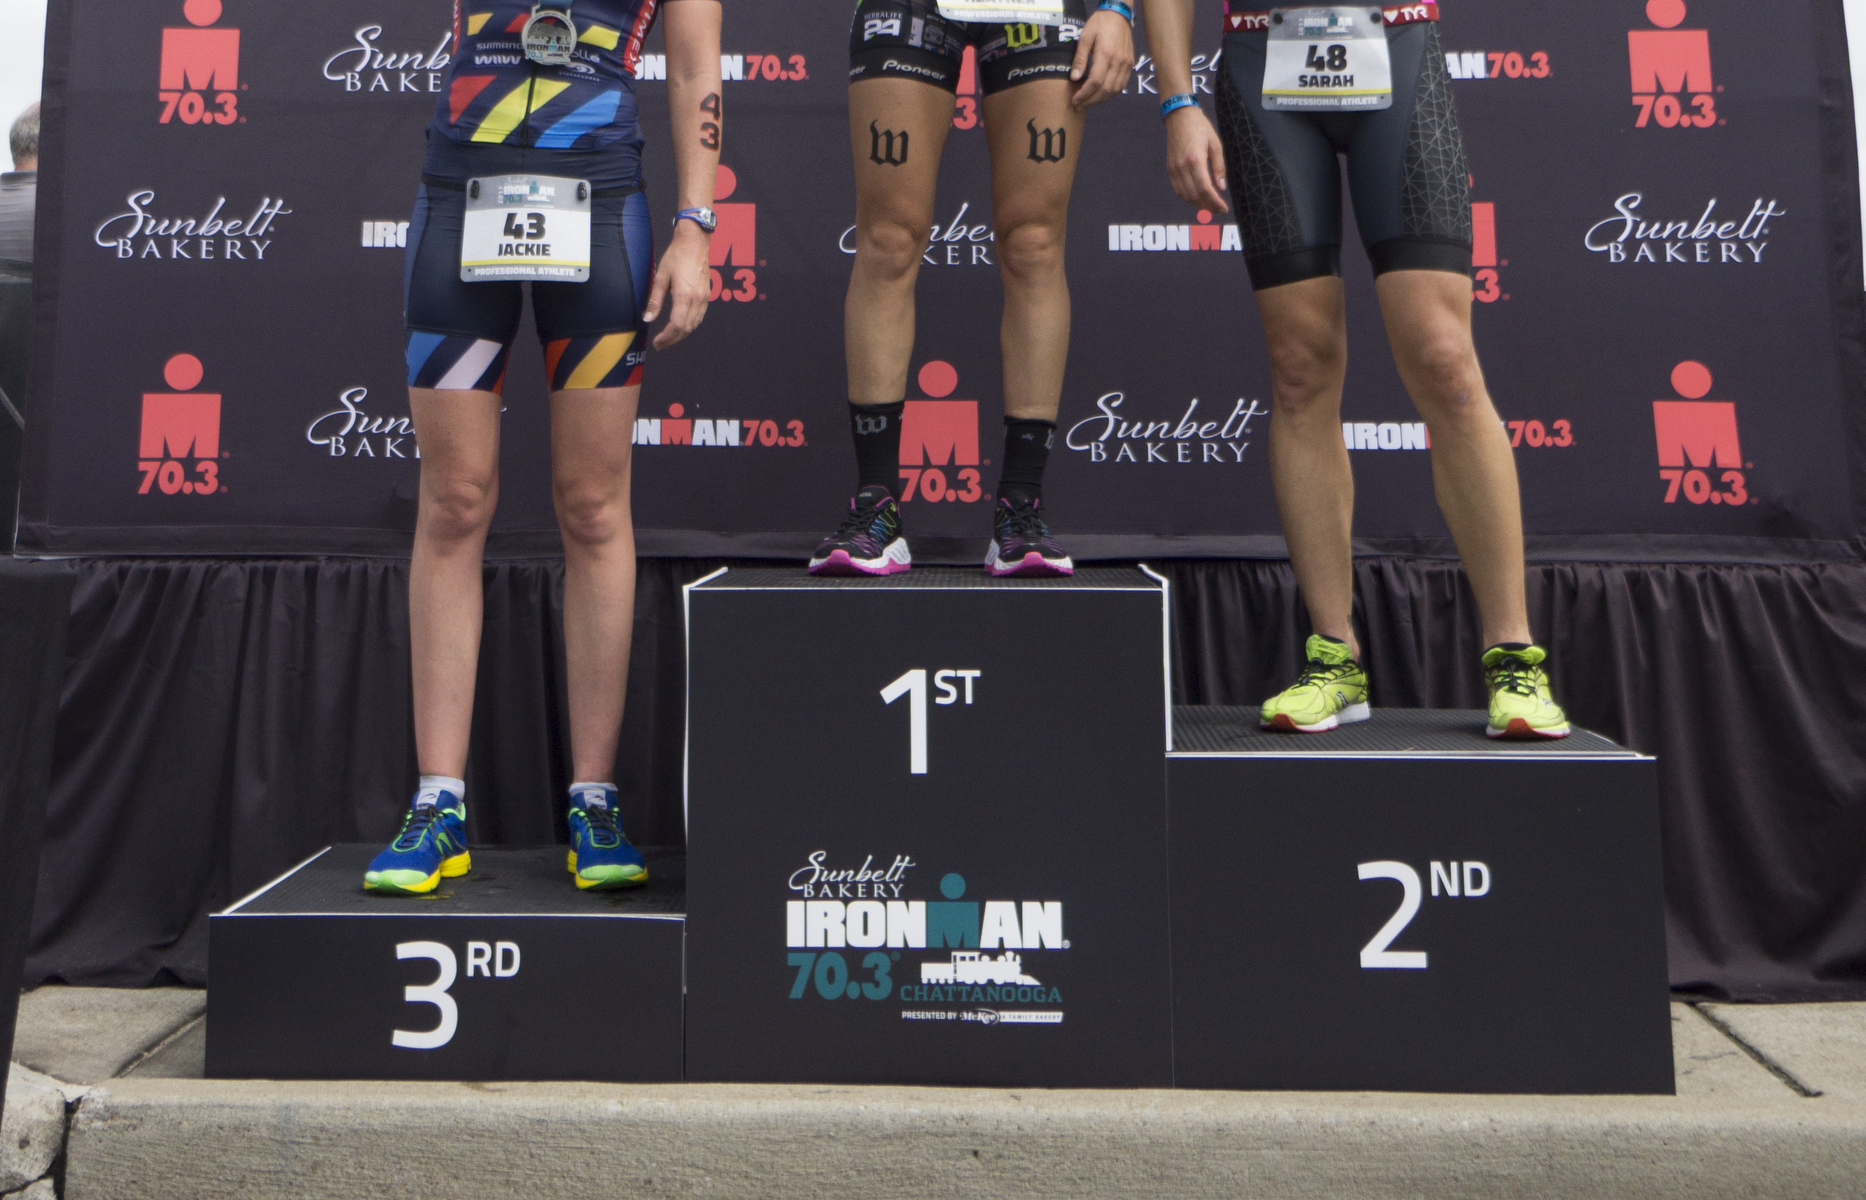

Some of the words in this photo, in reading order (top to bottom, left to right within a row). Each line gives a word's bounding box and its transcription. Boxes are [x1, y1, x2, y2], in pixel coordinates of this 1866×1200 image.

[1400, 4, 1428, 21] TYR
[863, 18, 901, 42] 24
[323, 25, 452, 81] Sunb
[1305, 44, 1348, 72] 48
[1487, 51, 1551, 79] 70.3
[746, 54, 807, 81] 70.3
[882, 59, 947, 80] Pioneer
[1007, 63, 1071, 81] Pioneer
[1298, 74, 1354, 88] SARAH
[346, 72, 442, 92] BAKE
[159, 92, 239, 126] 70.3
[1276, 96, 1340, 106] PROFESSIONAL
[1341, 96, 1378, 105] ATHLETE
[1632, 94, 1717, 128] 70.3
[95, 190, 293, 248] Sunbelt
[503, 212, 546, 240] 43
[1108, 209, 1243, 251] IRONMA
[1585, 193, 1786, 252] Sunbelt
[117, 238, 272, 260] BAKERY
[498, 243, 551, 257] JACKIE
[1608, 242, 1768, 264] BAKERY
[475, 267, 536, 276] PROFESSIONAL
[538, 268, 576, 277] ATHLETE
[708, 268, 758, 303] 0.3
[742, 419, 805, 448] 70.3
[1066, 392, 1269, 450] Sunbelt
[1508, 419, 1574, 448] 70.3
[1090, 441, 1250, 463] BAKERY
[138, 460, 219, 495] 70.3
[899, 467, 983, 503] 70.3
[1660, 469, 1749, 506] 70.3
[789, 851, 916, 890] Sunbelt
[803, 883, 904, 898] BAKERY
[786, 873, 1063, 949] IRONMAN
[786, 951, 893, 1000] 70.3
[900, 985, 1063, 1003] CHATTANOOGA
[901, 1011, 946, 1020] PRESENTED
[947, 1011, 957, 1020] BY
